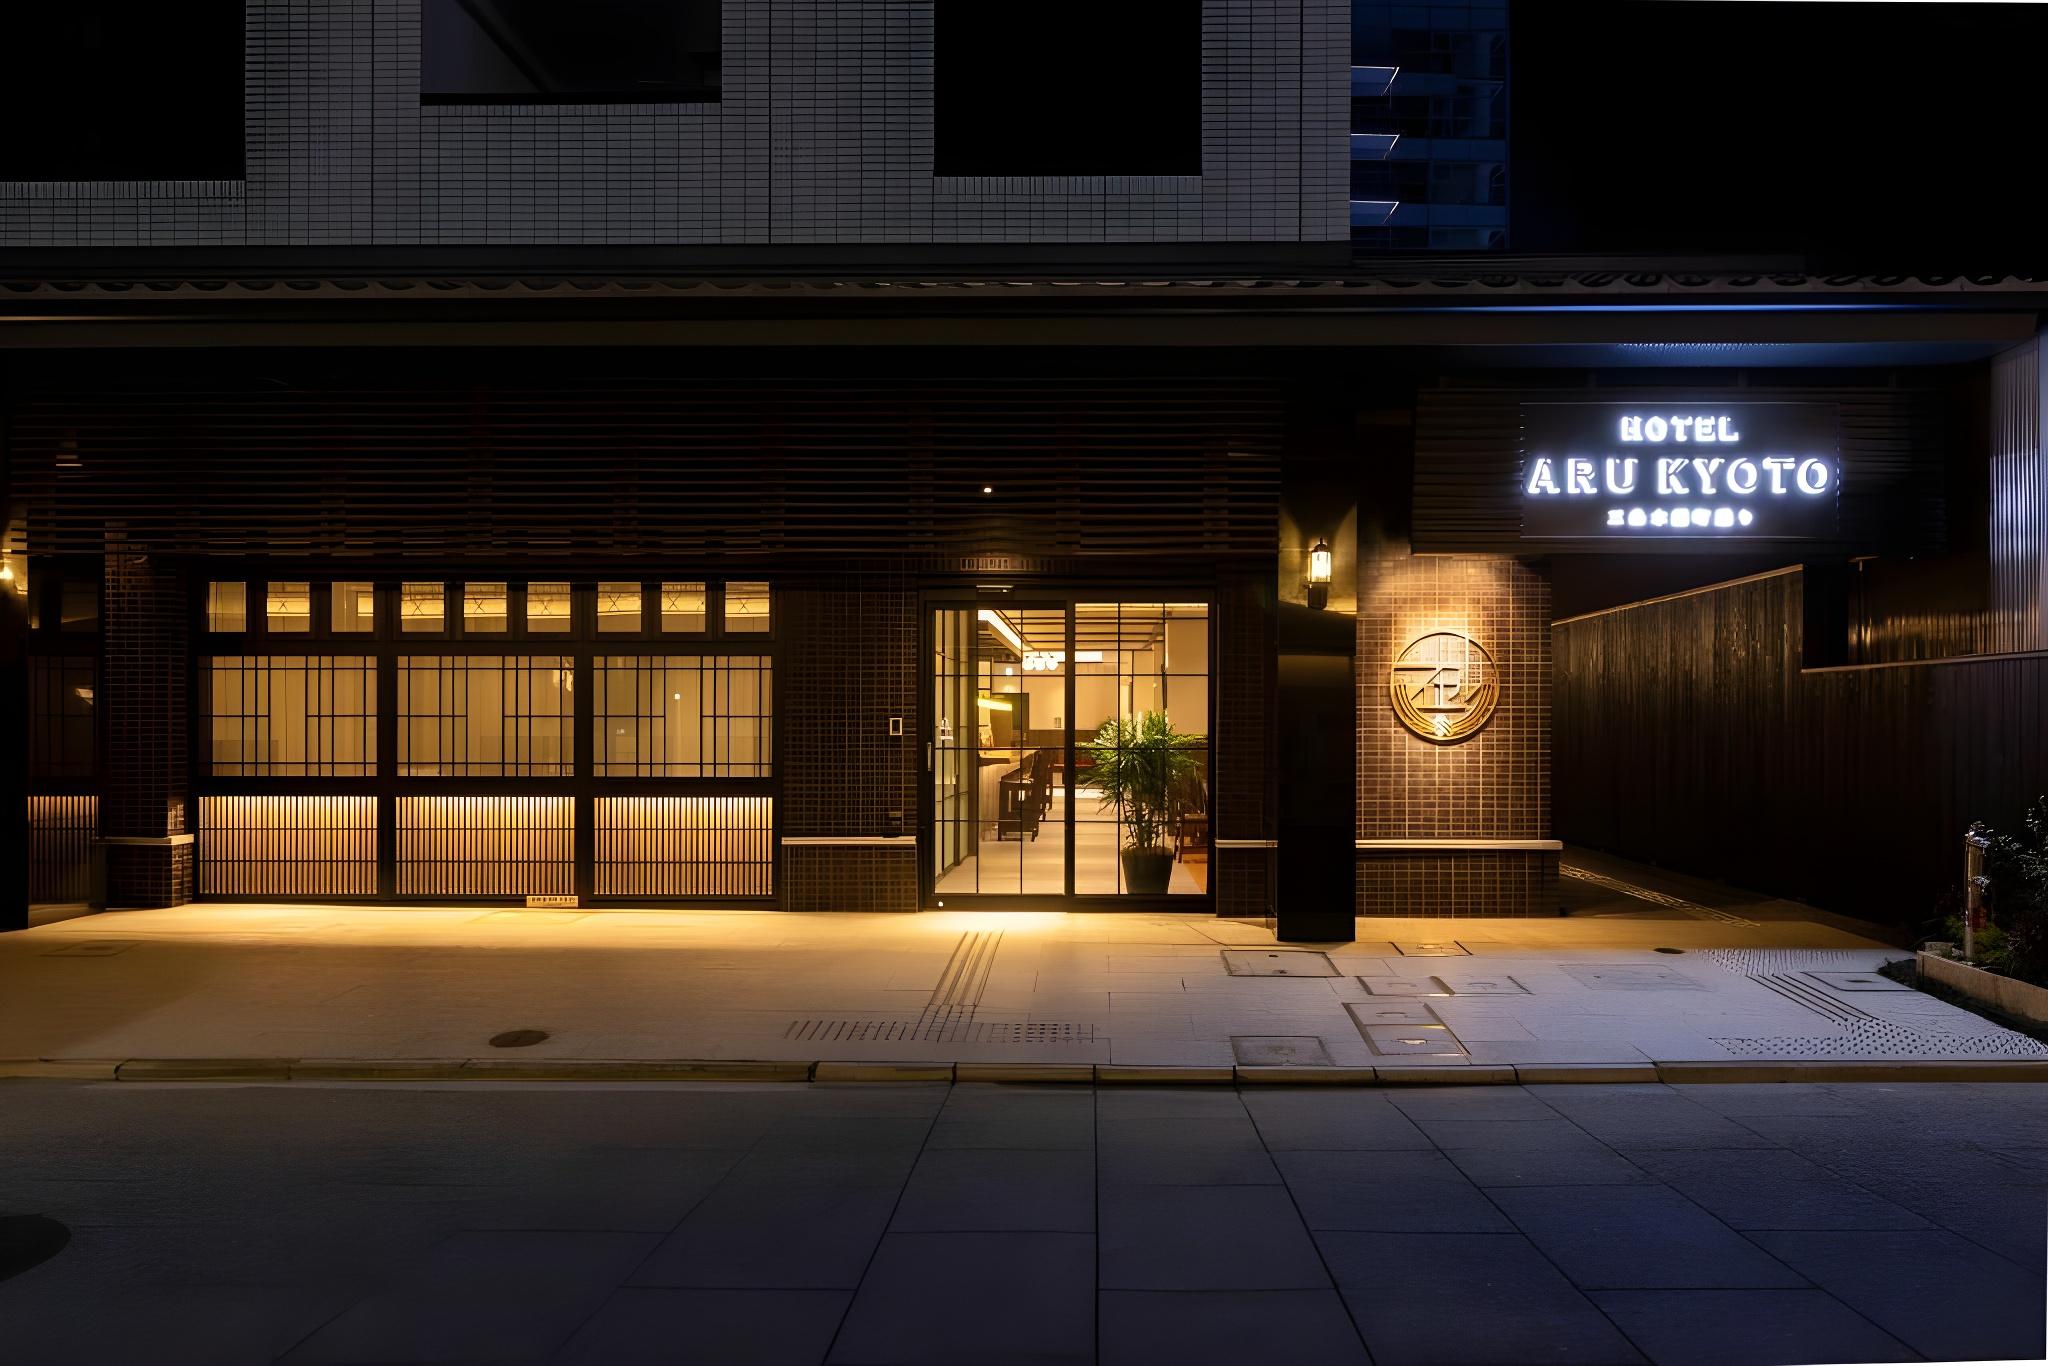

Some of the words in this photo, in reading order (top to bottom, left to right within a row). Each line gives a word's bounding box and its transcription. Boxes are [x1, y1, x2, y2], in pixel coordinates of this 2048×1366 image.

[1620, 415, 1739, 442] HOTEL
[1527, 457, 1639, 495] ARU
[1657, 457, 1828, 495] KYOTO
